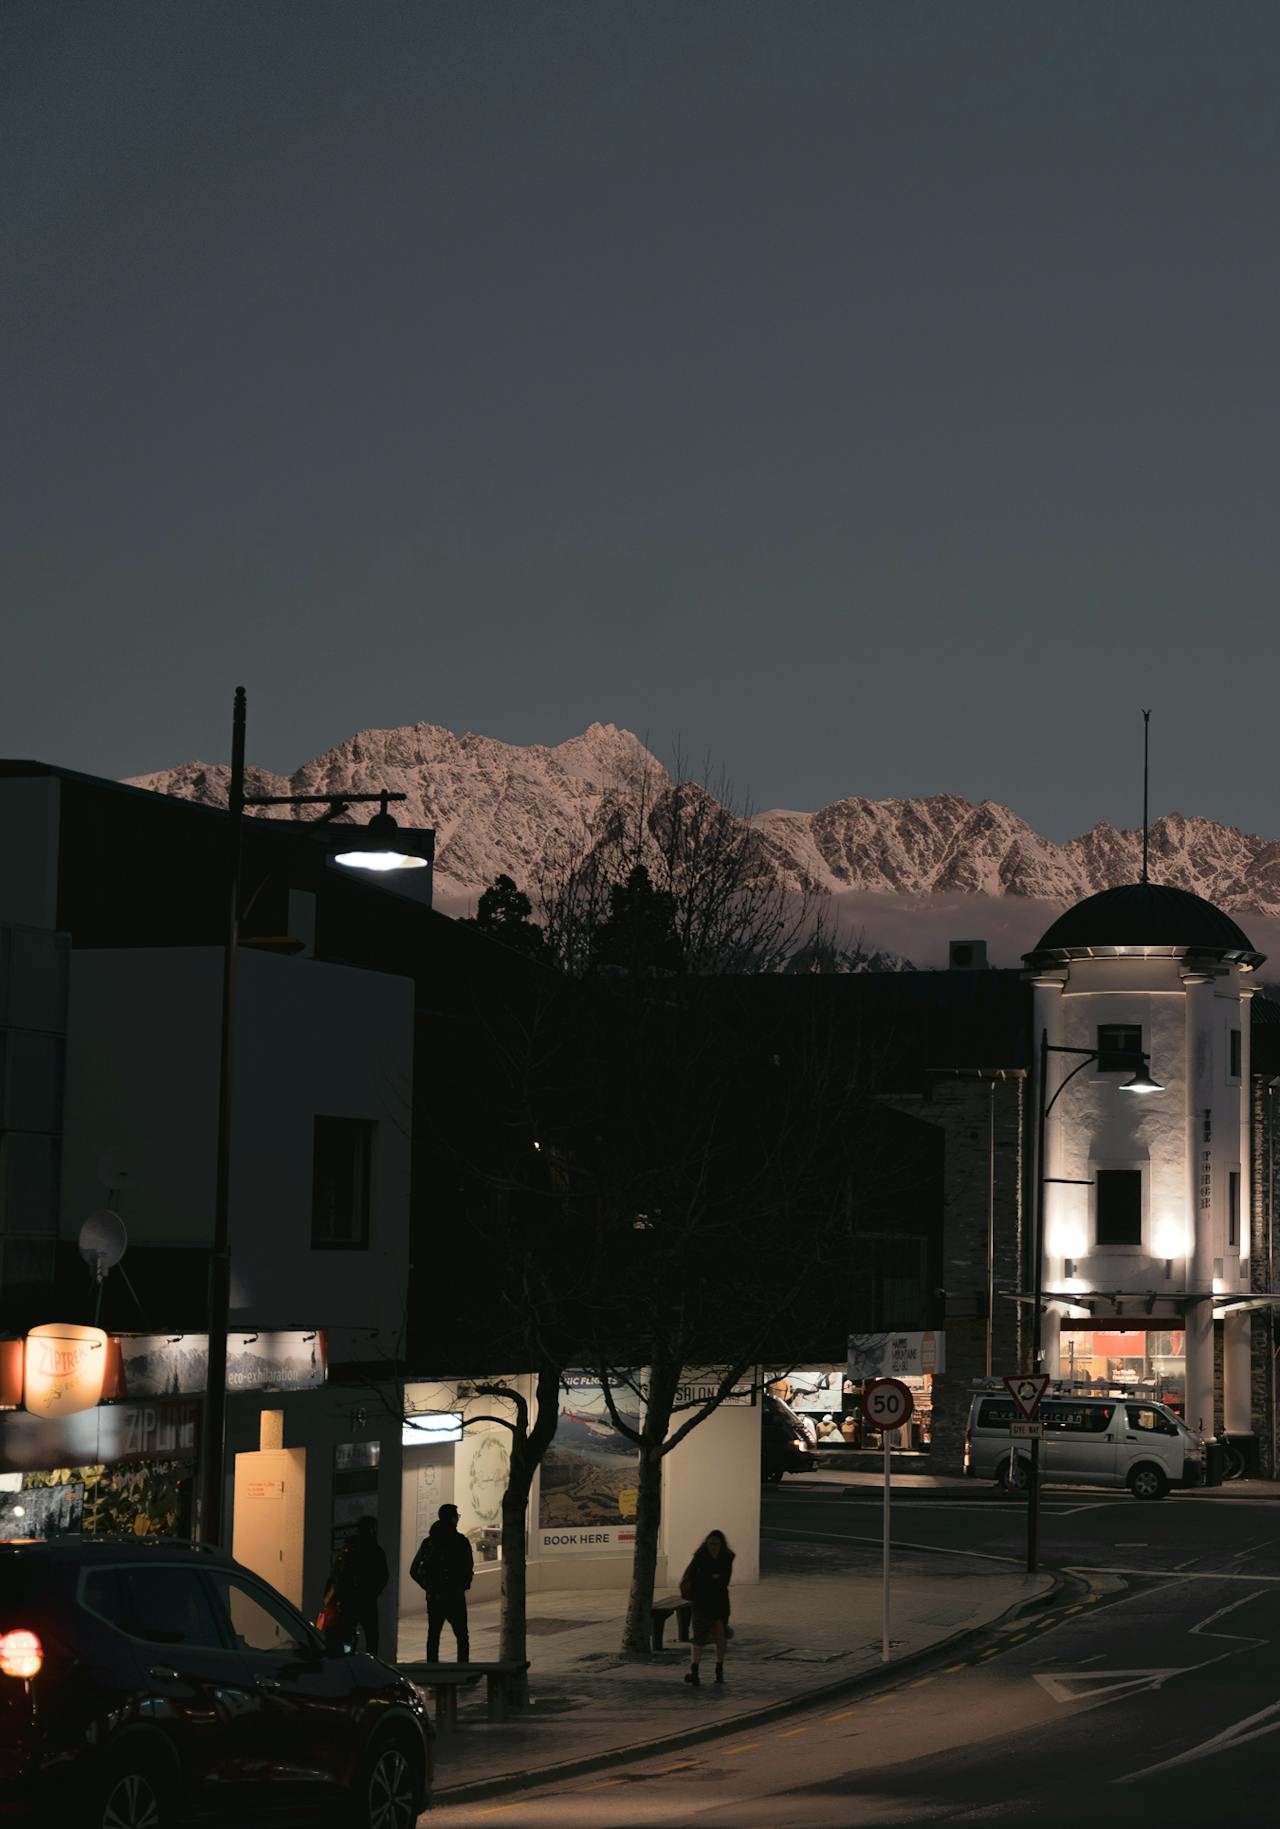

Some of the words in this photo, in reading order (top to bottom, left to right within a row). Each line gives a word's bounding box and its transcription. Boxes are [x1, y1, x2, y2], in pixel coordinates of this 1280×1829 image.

[580, 1376, 618, 1386] FLIGTS
[675, 1386, 715, 1401] SALON
[874, 1395, 899, 1414] 50
[127, 1405, 194, 1454] ZIPLINE
[1013, 1425, 1025, 1433] GIVE
[1028, 1425, 1039, 1433] WAY
[543, 1535, 577, 1546] BOOK
[580, 1533, 610, 1544] HERE
